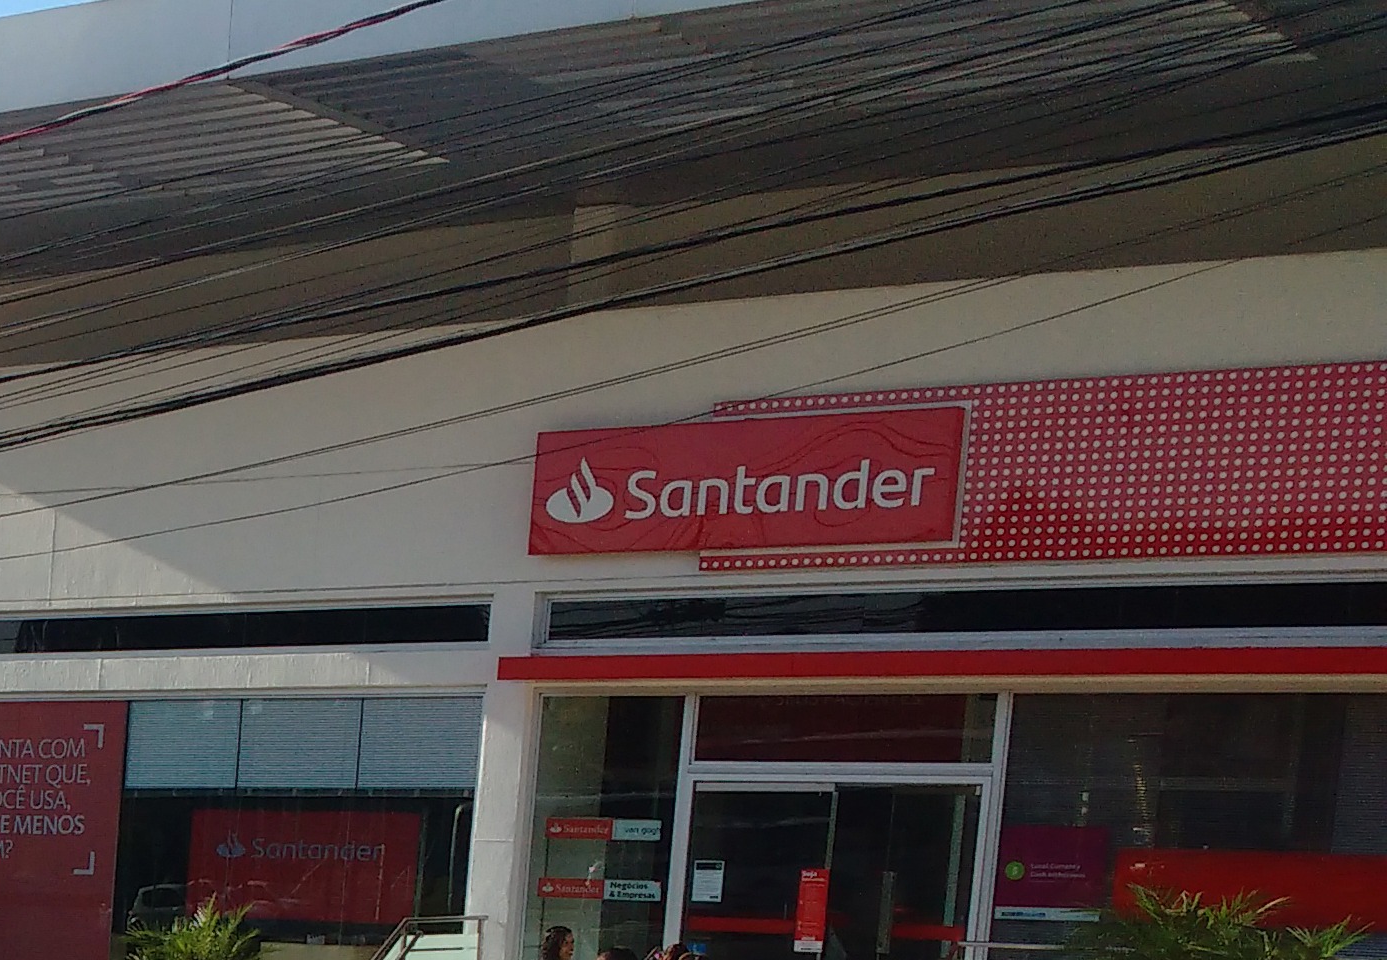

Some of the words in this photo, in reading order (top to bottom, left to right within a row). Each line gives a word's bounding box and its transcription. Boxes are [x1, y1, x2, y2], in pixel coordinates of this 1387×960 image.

[624, 458, 935, 520] Santander
[38, 737, 87, 759] COM
[45, 764, 92, 788] QUE,
[30, 790, 72, 812] USA,
[0, 814, 11, 834] E
[13, 814, 86, 836] MENOS
[563, 823, 610, 836] Santander
[250, 838, 385, 861] Santander
[555, 883, 600, 894] Santander
